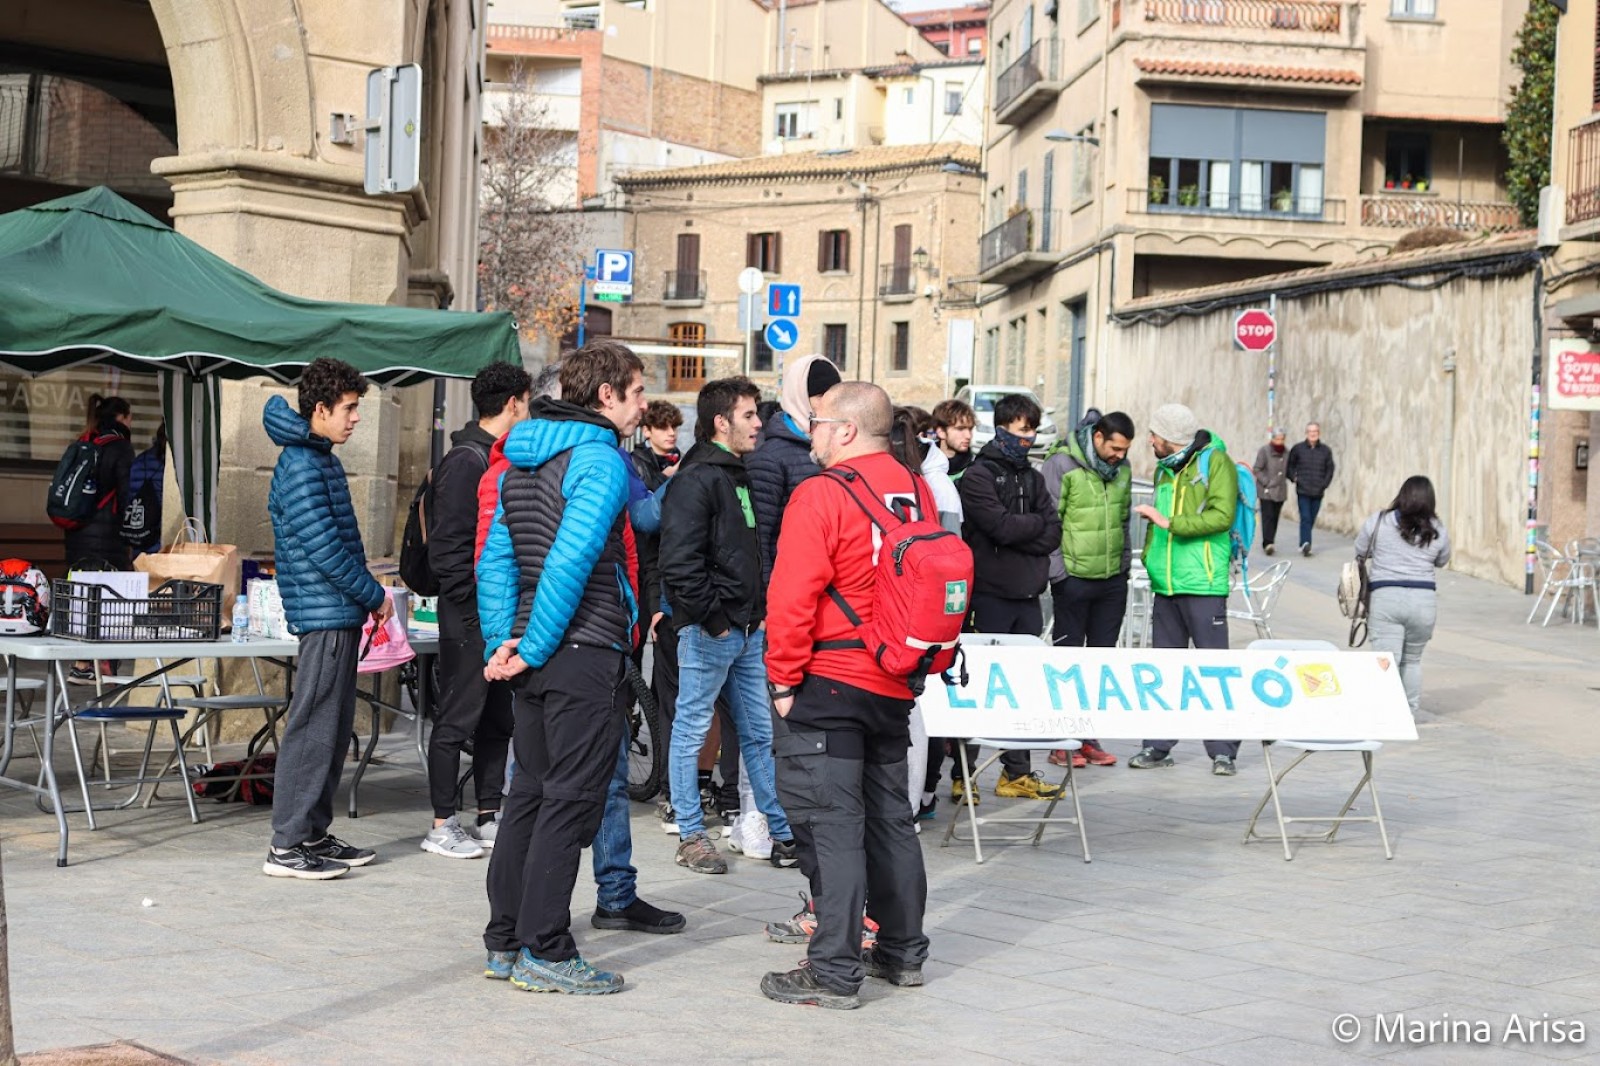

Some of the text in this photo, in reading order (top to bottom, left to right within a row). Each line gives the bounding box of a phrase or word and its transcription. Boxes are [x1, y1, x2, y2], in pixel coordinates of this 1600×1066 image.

[603, 253, 627, 281] P
[1239, 325, 1273, 337] STOP
[946, 655, 1293, 711] LA MARATÓ
